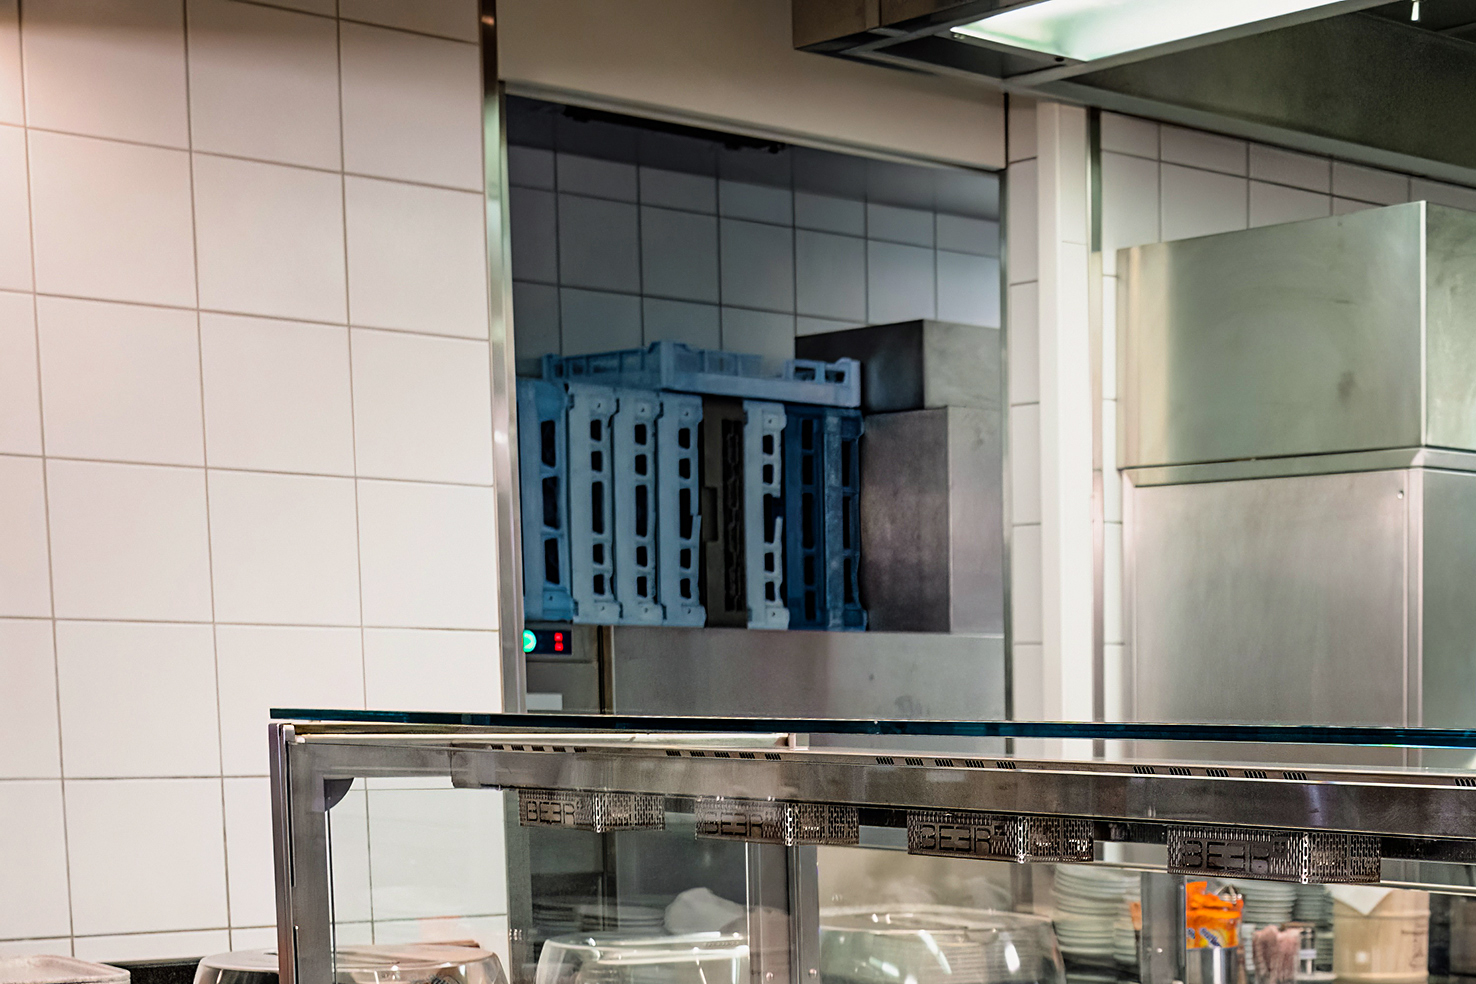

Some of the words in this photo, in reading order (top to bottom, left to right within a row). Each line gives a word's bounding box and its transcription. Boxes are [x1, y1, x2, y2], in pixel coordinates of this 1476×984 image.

[526, 801, 576, 825] BEER
[704, 811, 765, 838] BEER
[919, 824, 993, 854] BEER
[1181, 838, 1271, 874] BEER
